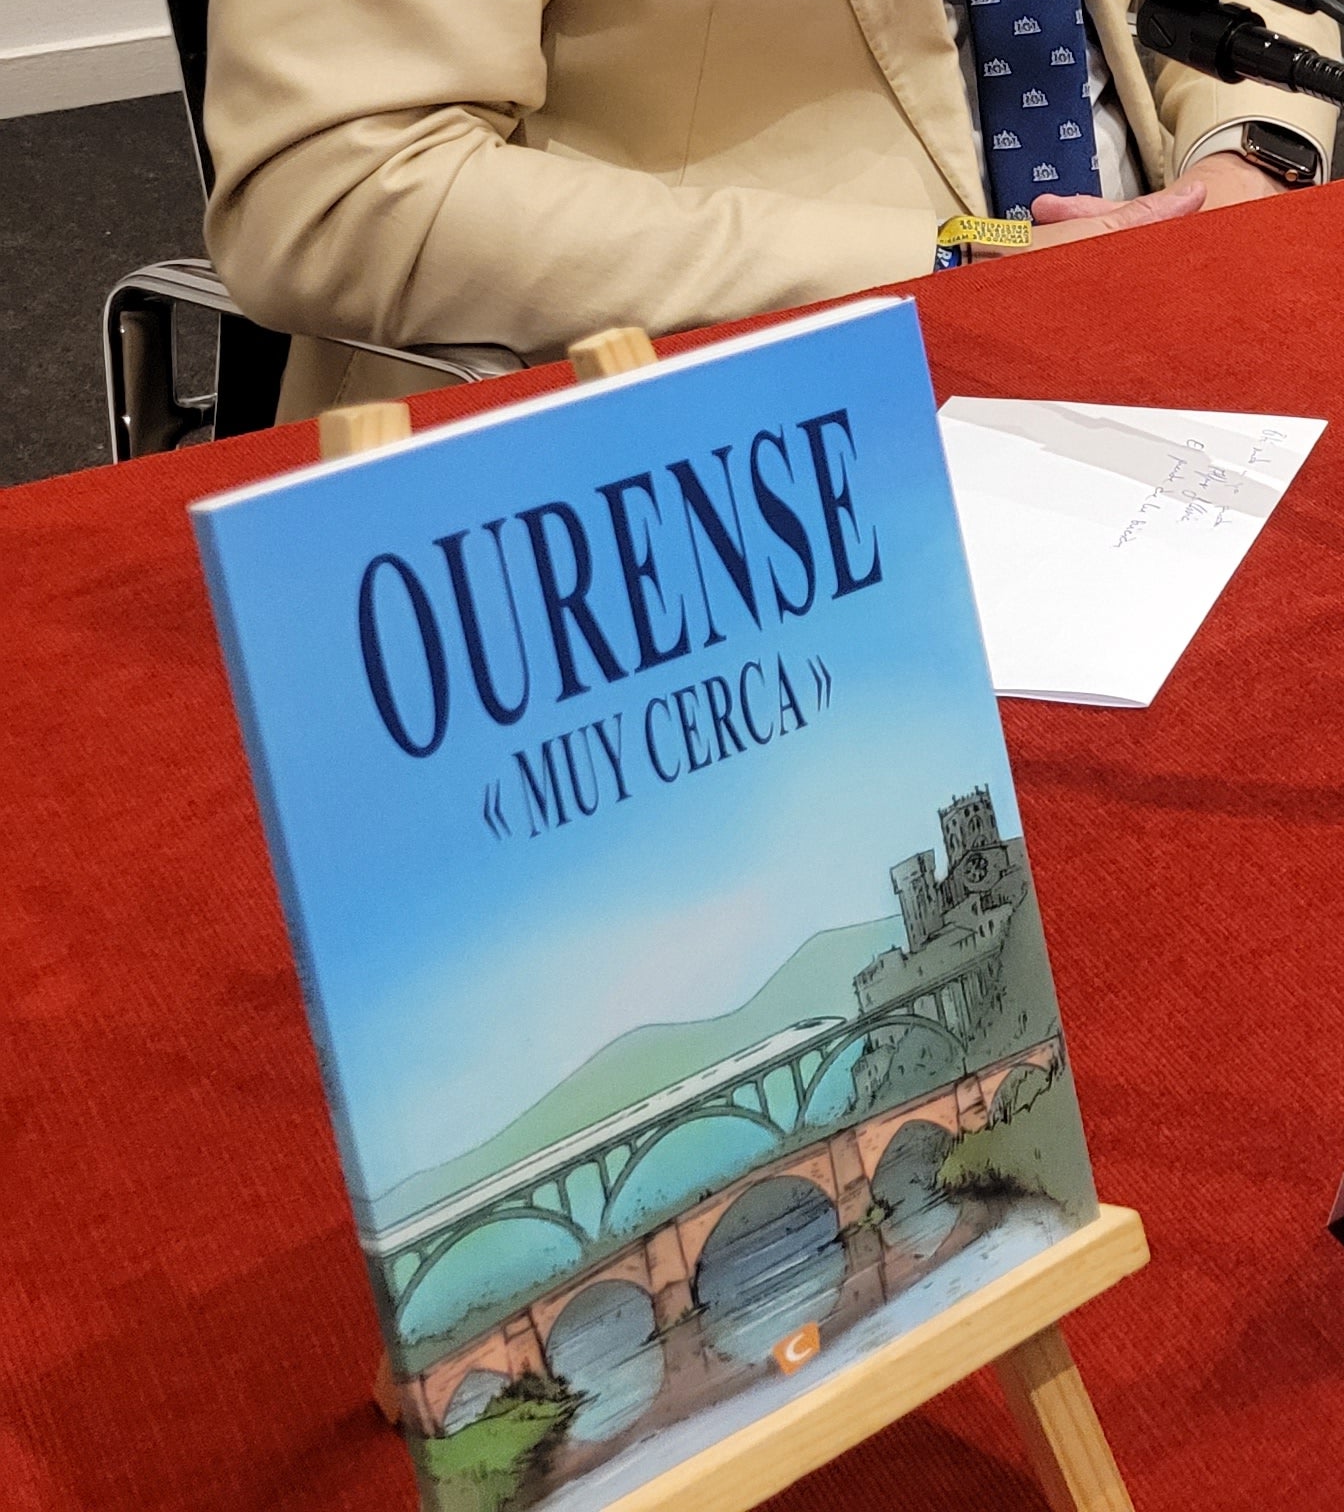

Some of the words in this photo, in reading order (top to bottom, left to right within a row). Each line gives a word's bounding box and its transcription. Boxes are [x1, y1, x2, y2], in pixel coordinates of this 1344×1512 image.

[358, 407, 884, 759] OURENSE
[512, 712, 633, 839] MUY
[644, 651, 808, 784] CERCA
